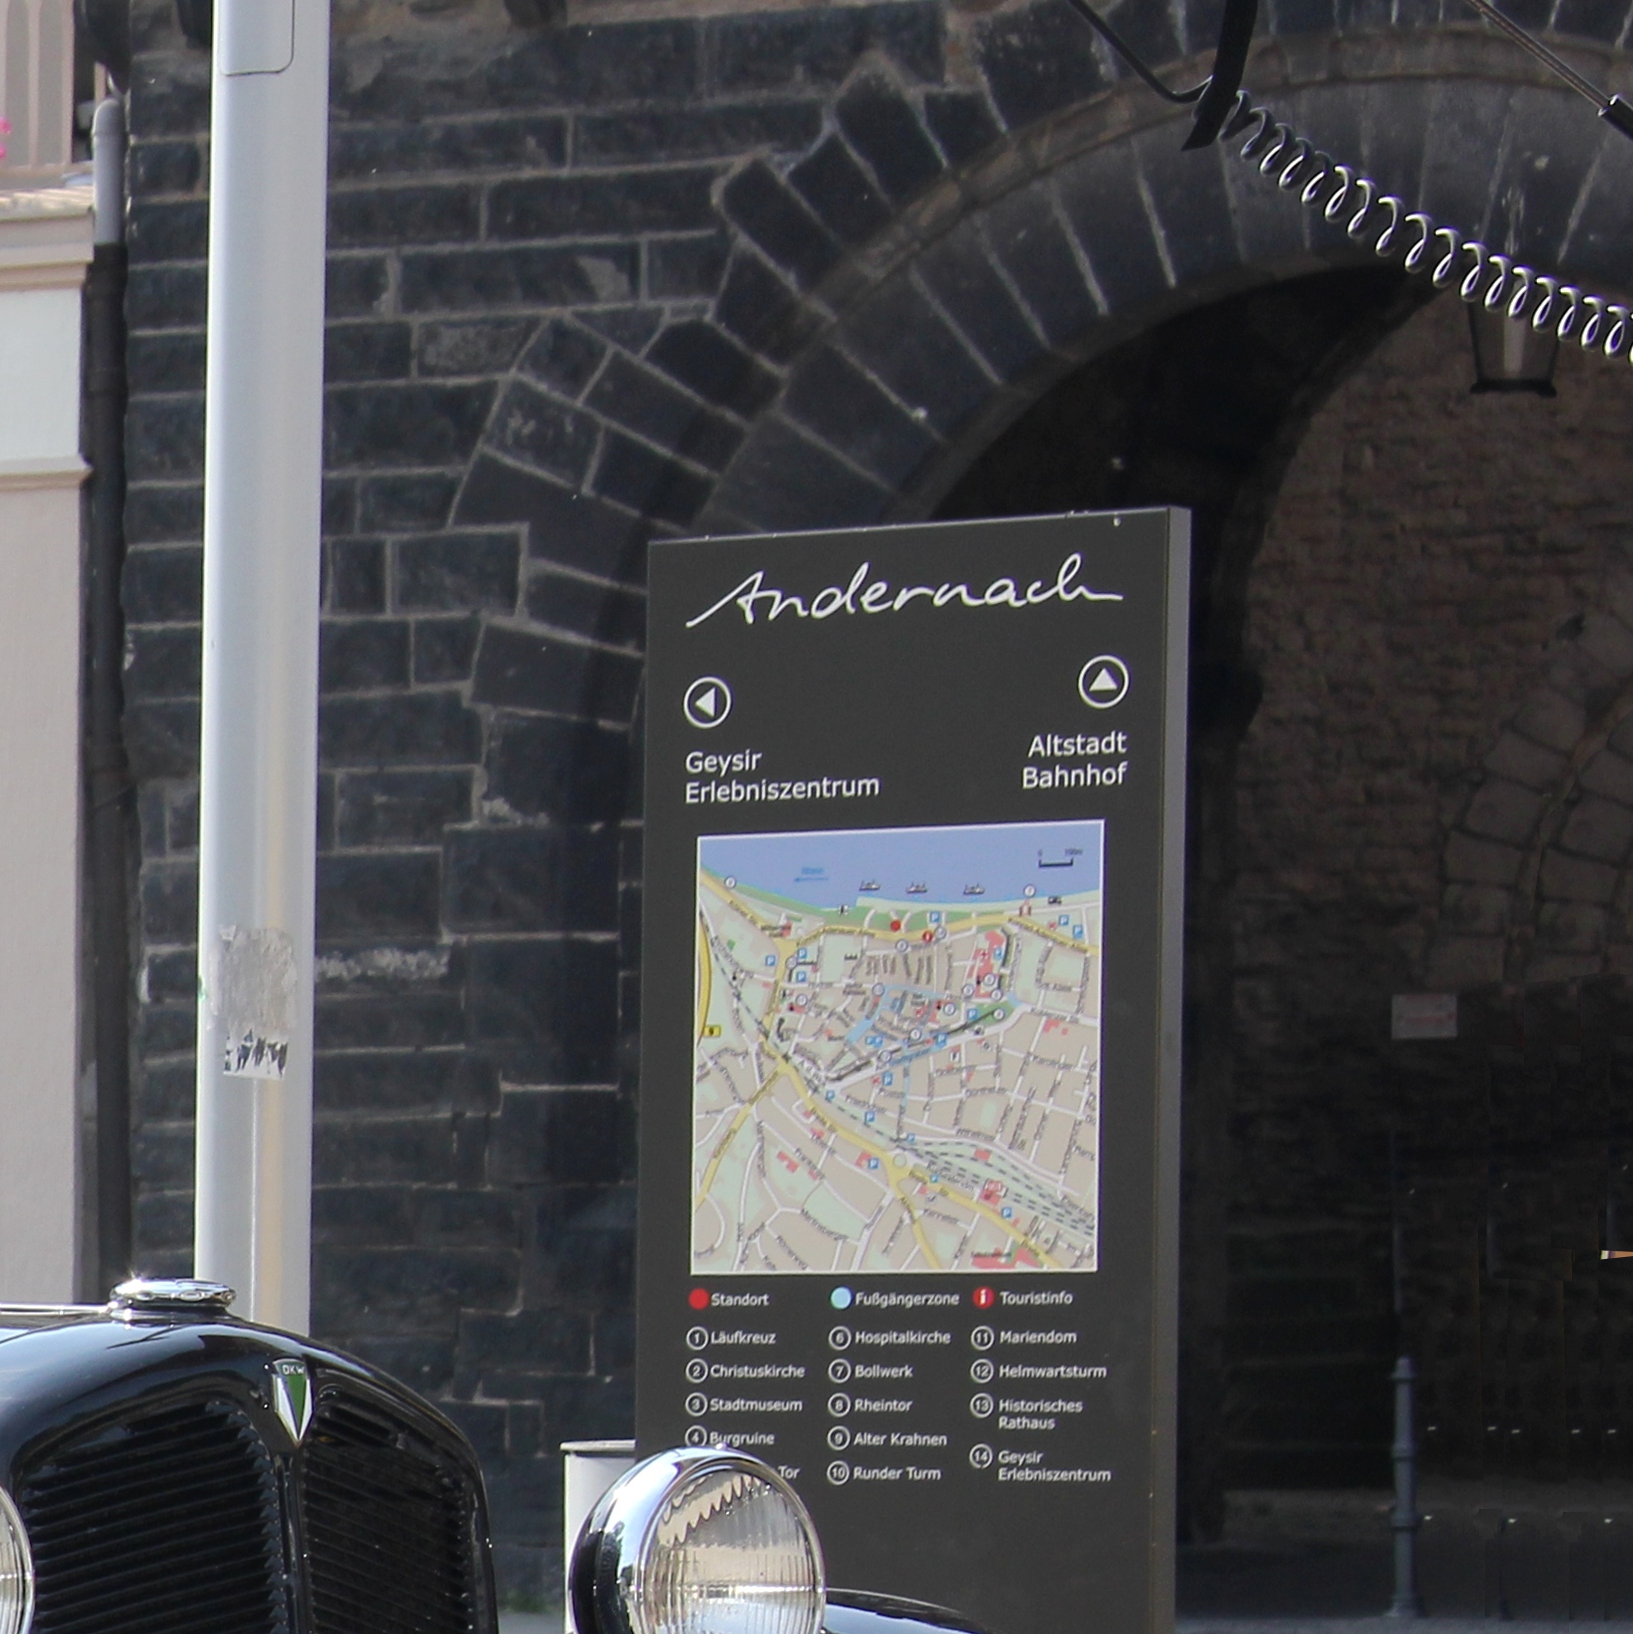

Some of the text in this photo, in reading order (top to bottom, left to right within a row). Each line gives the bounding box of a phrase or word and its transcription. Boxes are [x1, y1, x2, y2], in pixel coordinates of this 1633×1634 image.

[686, 552, 1123, 628] Andernach
[1028, 731, 1128, 758] Altstadt
[685, 749, 762, 778] Geysir
[1022, 762, 1128, 790] Bahnhof
[685, 776, 880, 804] Erlebniszentrum
[711, 1293, 769, 1306] Standort
[855, 1291, 960, 1308] Fußgängerzone
[999, 1291, 1073, 1305] Touristinfo
[711, 1331, 776, 1344] Läufkreuz
[855, 1331, 951, 1346] Hospitalkirche
[999, 1330, 1077, 1344] Mariendom
[282, 1364, 305, 1375] DKW
[710, 1364, 805, 1378] Christuskirche
[855, 1364, 913, 1378] Bollwerk
[998, 1364, 1107, 1378] Helmwartsturm
[710, 1398, 803, 1412] Stadtmuseum
[854, 1398, 913, 1412] Rheintor
[998, 1398, 1083, 1413] Historisches
[998, 1416, 1056, 1430] Rathaus
[709, 1431, 775, 1447] Burgruine
[853, 1432, 886, 1446] Alter
[890, 1432, 947, 1446] Krahnen
[998, 1450, 1043, 1466] Geysir
[778, 1465, 800, 1479] Tor
[853, 1466, 903, 1480] Runder
[906, 1467, 941, 1480] Turm
[998, 1467, 1112, 1482] Erlebniszentrum
